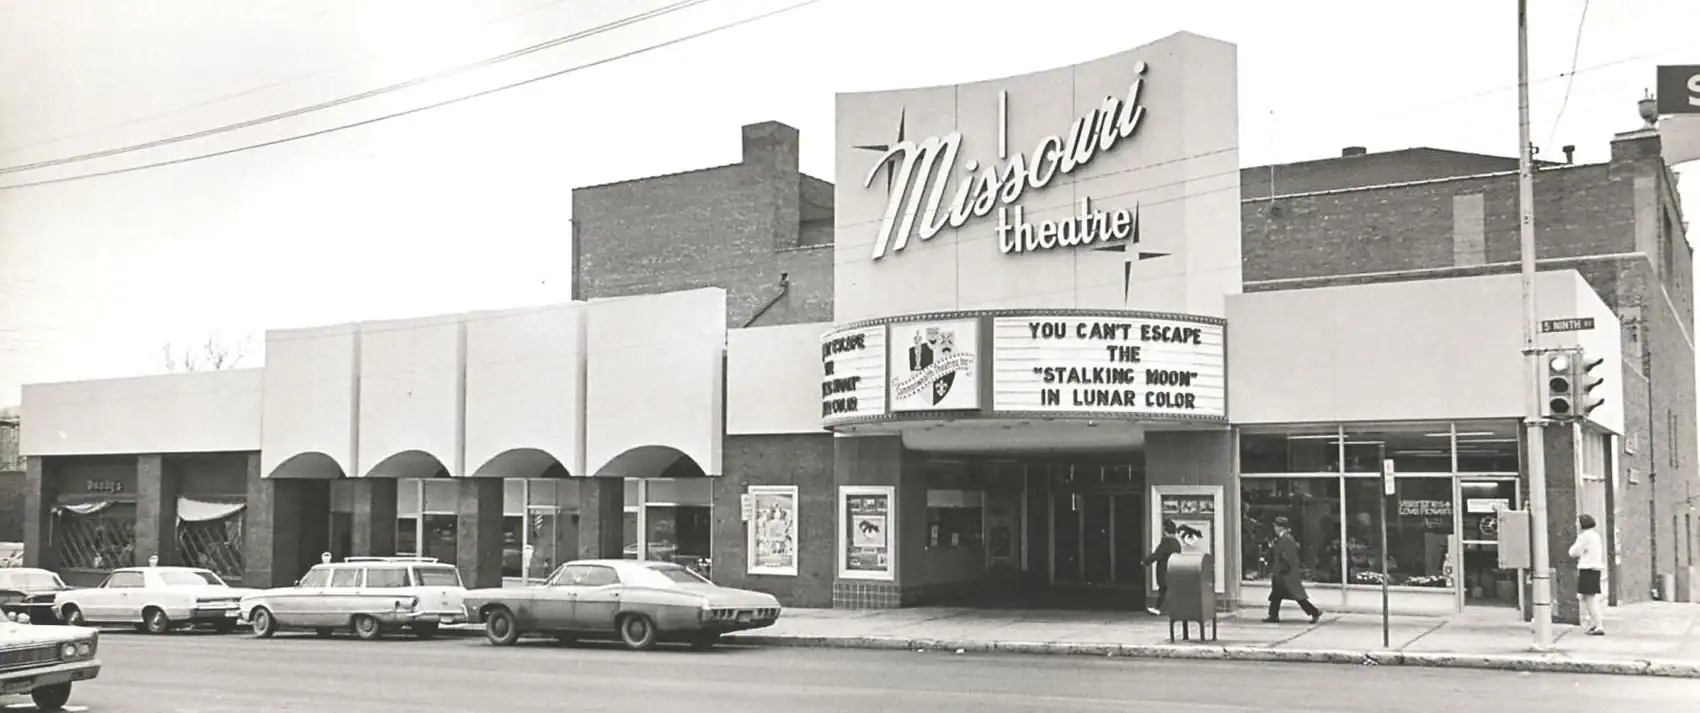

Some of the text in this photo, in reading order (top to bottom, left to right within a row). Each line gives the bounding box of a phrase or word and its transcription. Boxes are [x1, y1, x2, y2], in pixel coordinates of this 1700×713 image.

[864, 60, 1147, 260] Missouri
[995, 196, 1132, 254] theatre
[1028, 322, 1202, 345] YOU CAN'T ESCAPE
[1543, 322, 1550, 331] S
[1553, 320, 1581, 330] NINTH
[1106, 345, 1141, 363] THE
[1033, 367, 1198, 387] "STALKING MOON"
[1040, 389, 1196, 410] IN LUNAR COLOR
